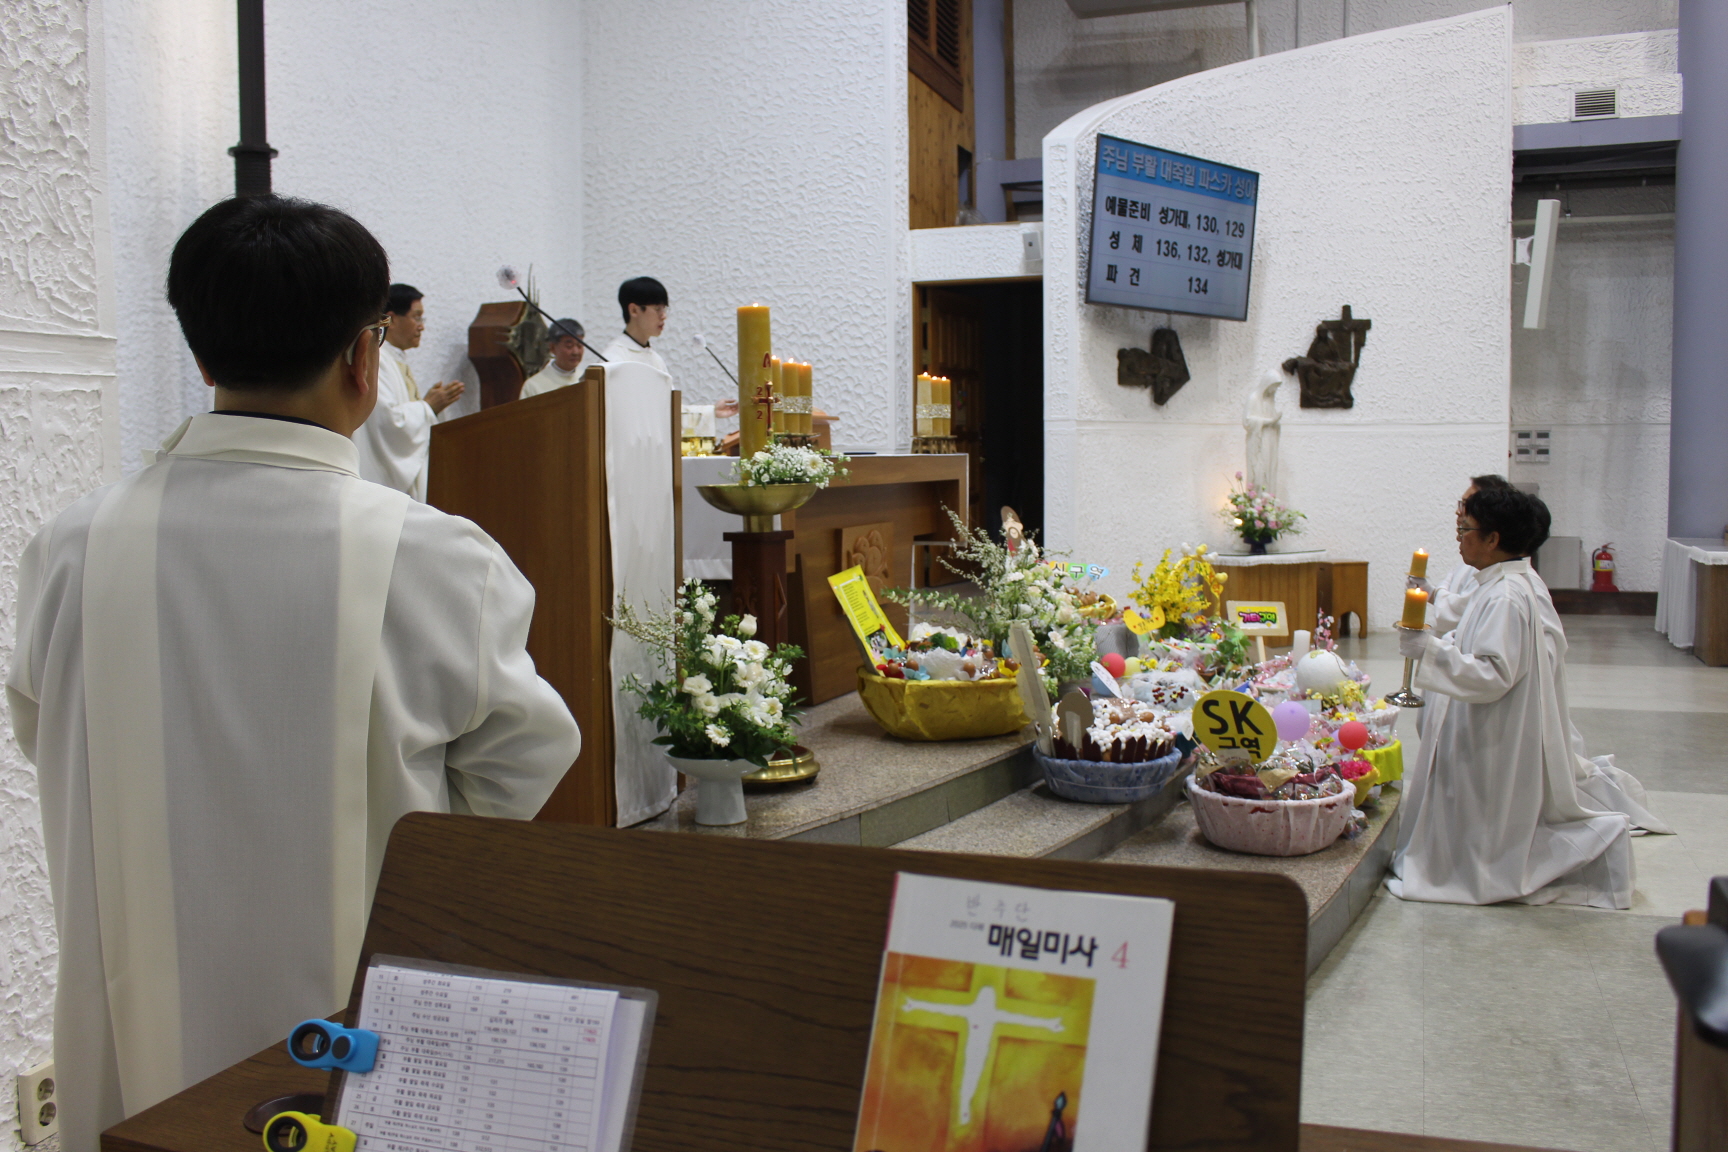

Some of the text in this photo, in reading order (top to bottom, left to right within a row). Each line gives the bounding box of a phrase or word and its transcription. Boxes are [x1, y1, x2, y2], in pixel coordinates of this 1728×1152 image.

[1102, 145, 1128, 172] 주님
[1132, 151, 1157, 179] 부활
[1160, 159, 1196, 187] 대축일
[1199, 167, 1232, 196] 파스카
[1105, 195, 1150, 221] 예물준비
[1196, 214, 1219, 236] 130,
[1225, 220, 1245, 238] 129
[1156, 239, 1243, 270] 136, 132, 성가대
[1188, 277, 1209, 295] 134
[1202, 699, 1264, 735] SK
[988, 923, 1098, 967] 매일미사
[1111, 941, 1130, 968] 4
